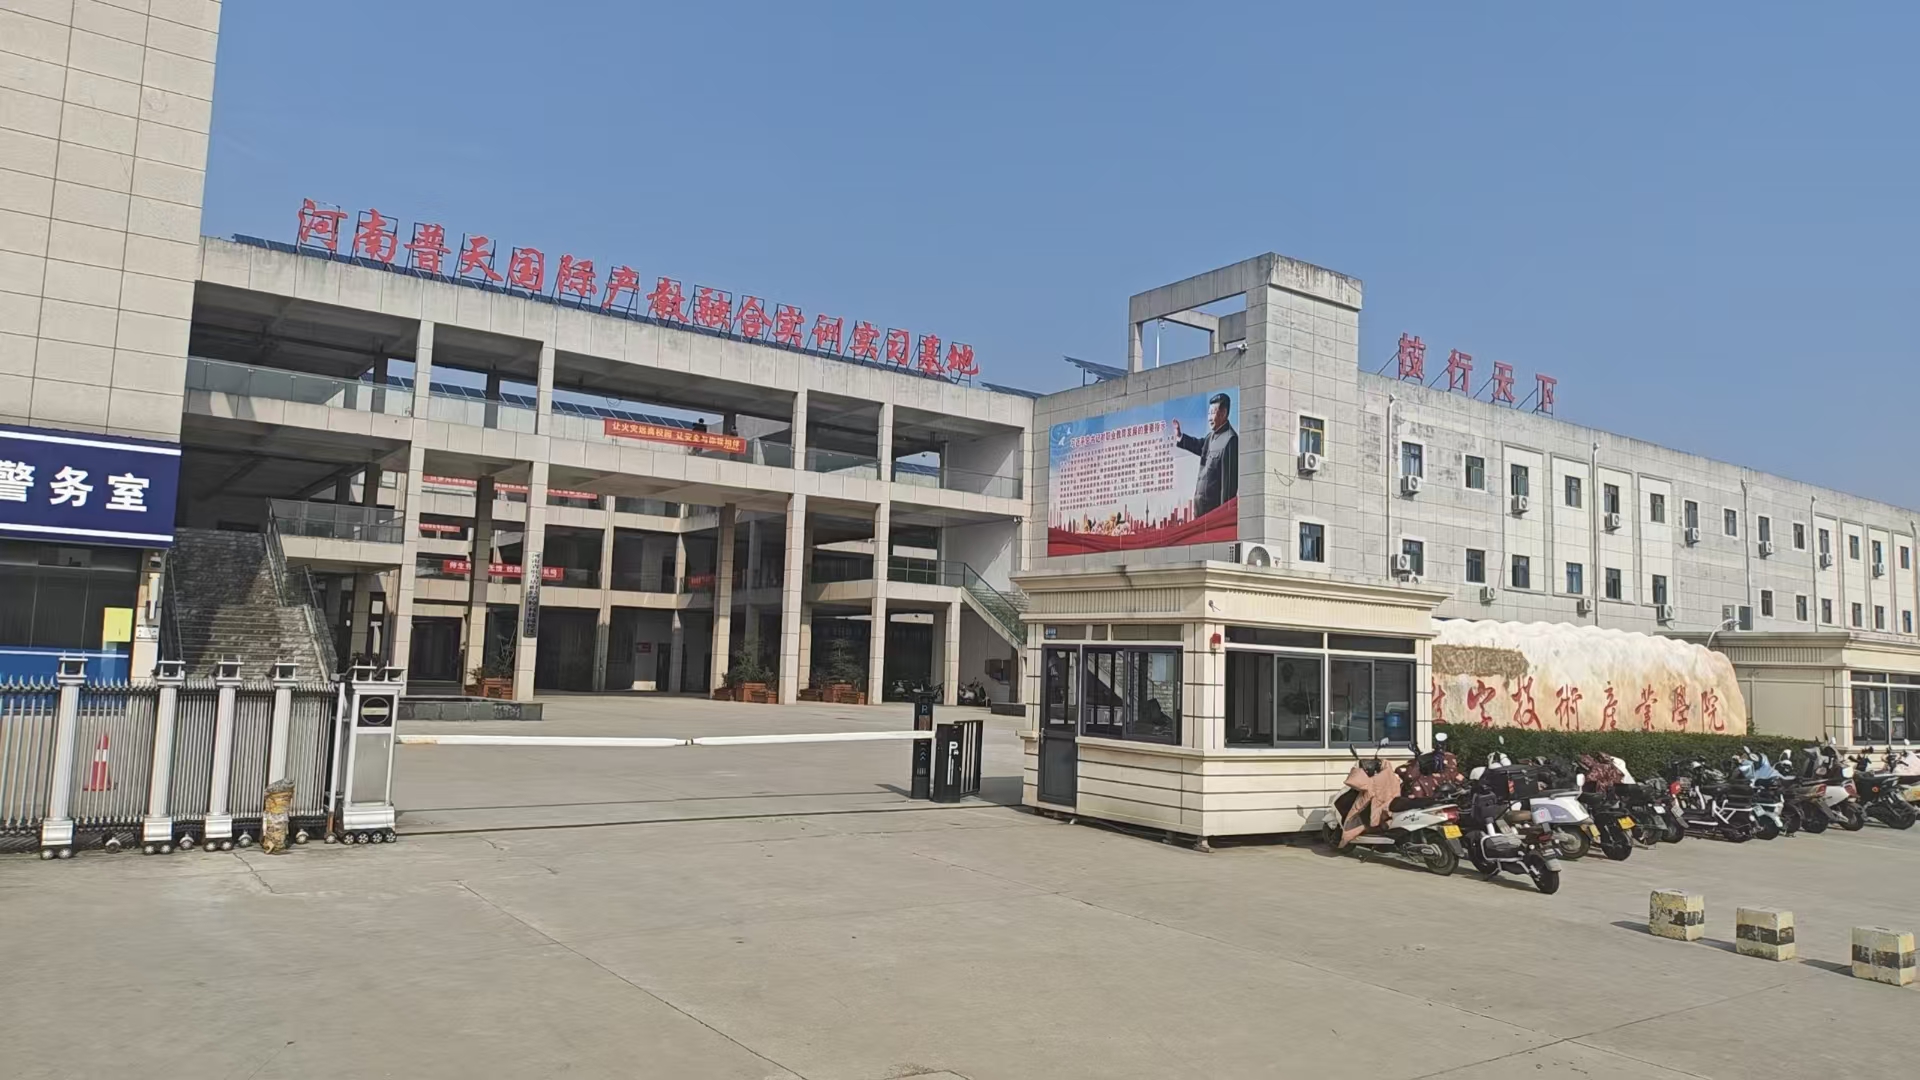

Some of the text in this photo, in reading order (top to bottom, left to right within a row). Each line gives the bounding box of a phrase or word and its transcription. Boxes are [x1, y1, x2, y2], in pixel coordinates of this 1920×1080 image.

[298, 198, 979, 376] 河南普天国际产教融合实训实习基地
[1398, 332, 1558, 412] 技行天下
[0, 460, 150, 512] 警务室
